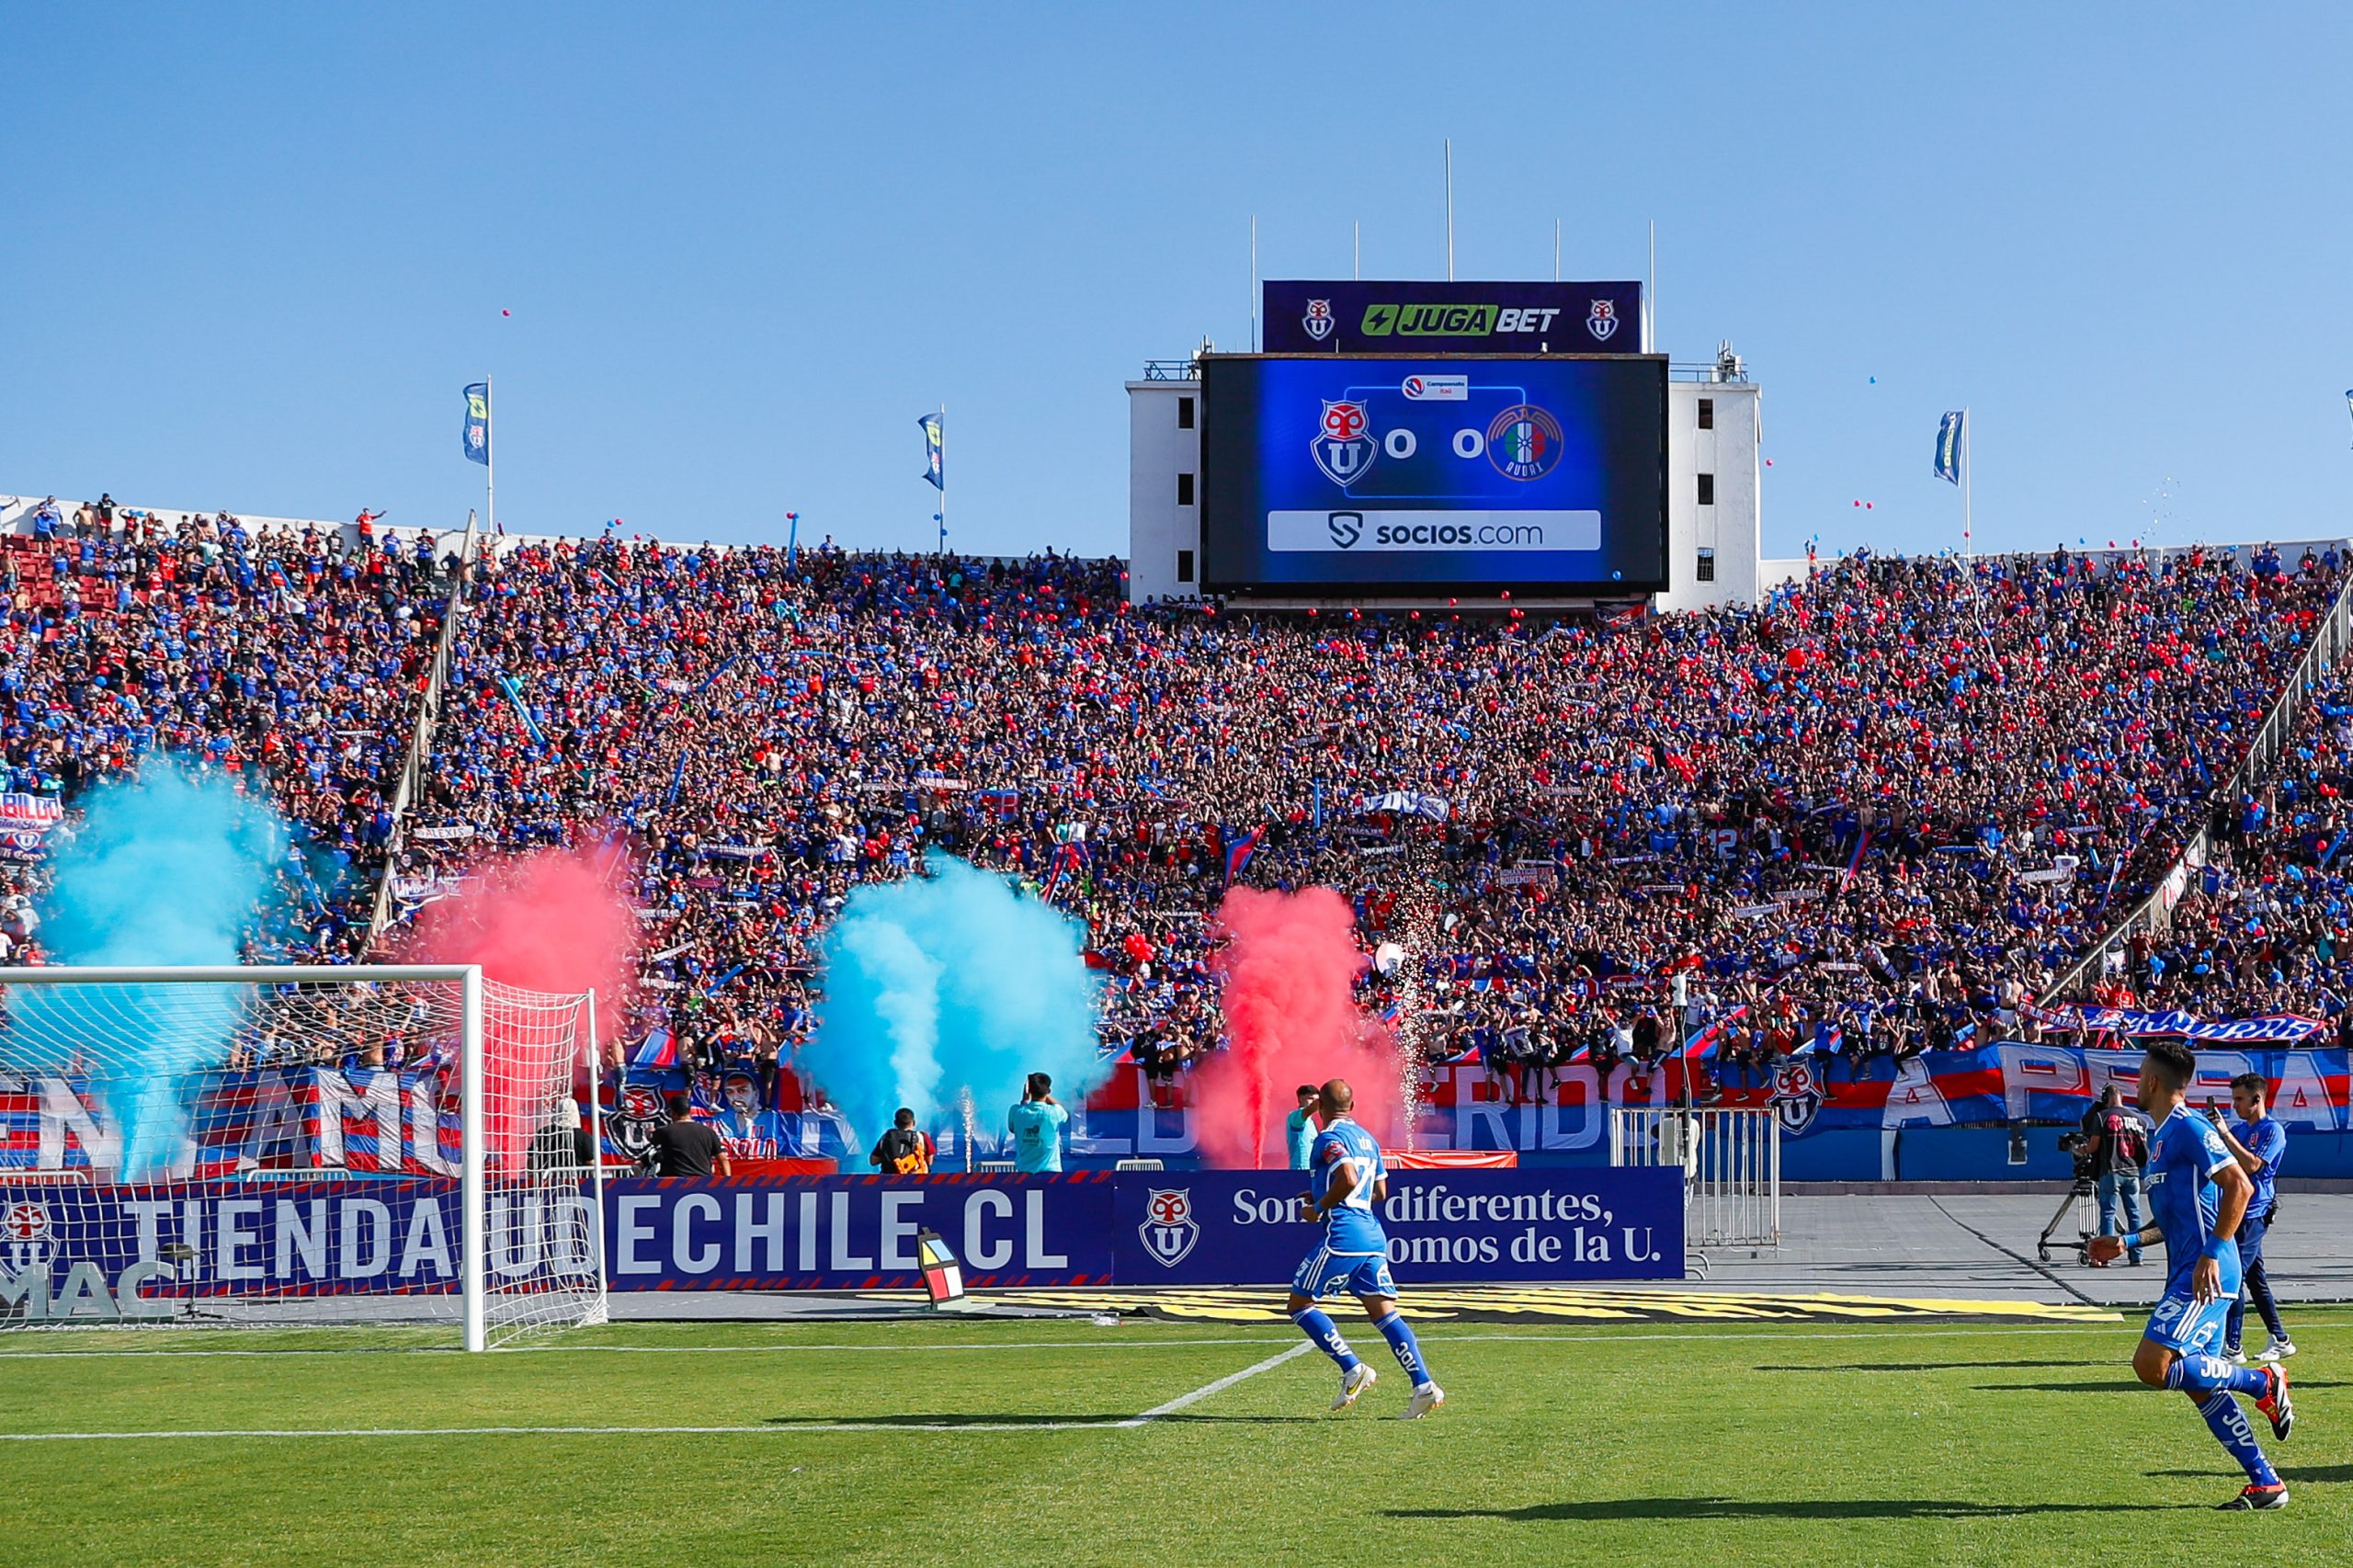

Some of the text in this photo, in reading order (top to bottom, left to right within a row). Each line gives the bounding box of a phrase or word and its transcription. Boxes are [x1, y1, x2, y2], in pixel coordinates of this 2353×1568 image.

[1384, 428, 1417, 459] 0
[1452, 428, 1484, 459] 0
[1506, 461, 1544, 477] AUDAX
[1500, 875, 1539, 885] BOHEMIS
[1385, 1187, 1614, 1227] diferentes,
[1387, 1226, 1662, 1264] omos de la U.
